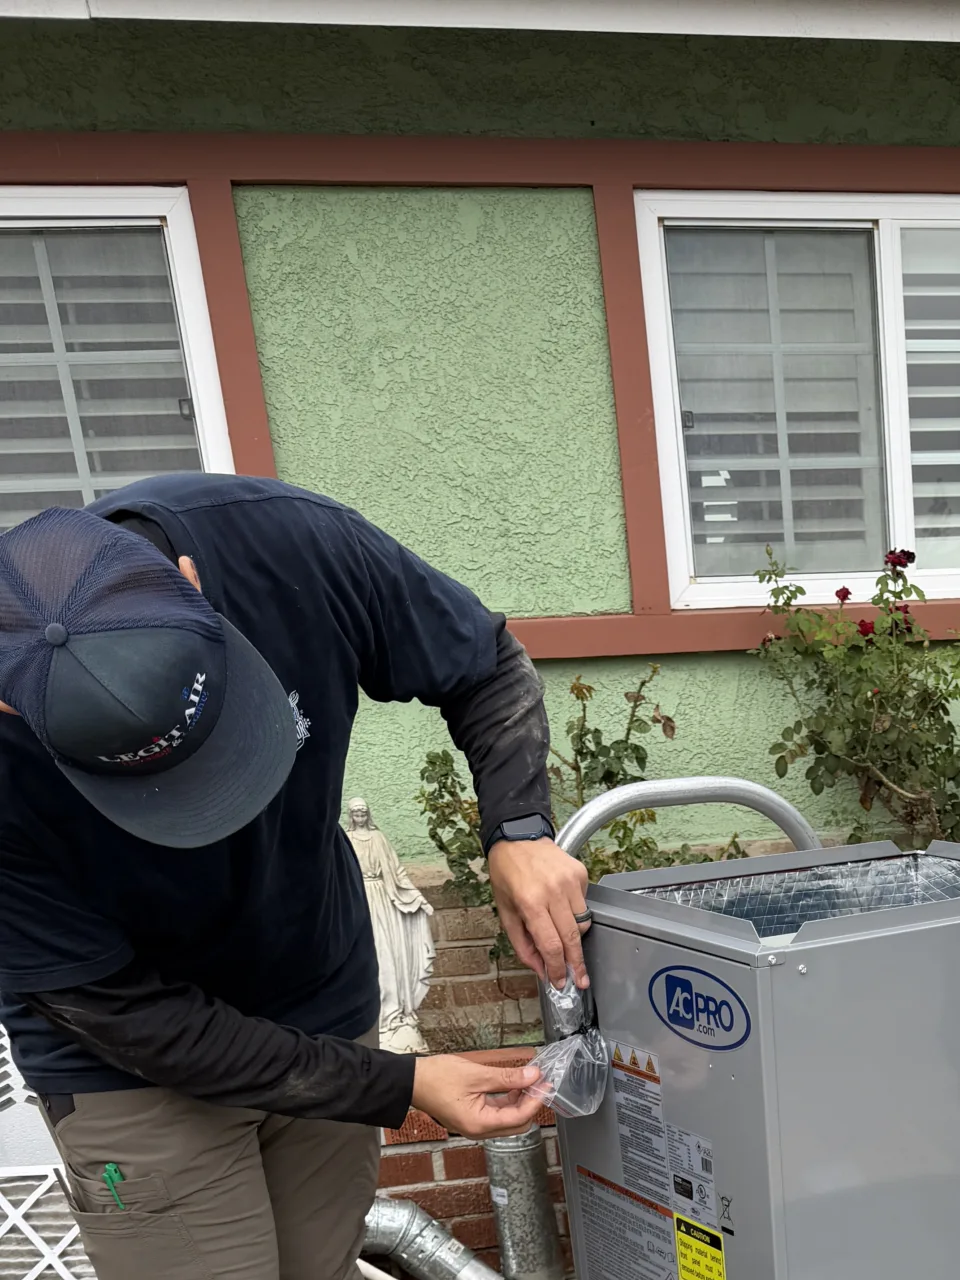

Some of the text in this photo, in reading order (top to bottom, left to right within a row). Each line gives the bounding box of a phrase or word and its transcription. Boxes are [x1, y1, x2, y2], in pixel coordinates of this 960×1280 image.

[96, 673, 206, 762] LEGIT AIR
[669, 986, 734, 1032] AC PRO
[696, 1024, 715, 1037] .com
[690, 1228, 710, 1243] CAUTION
